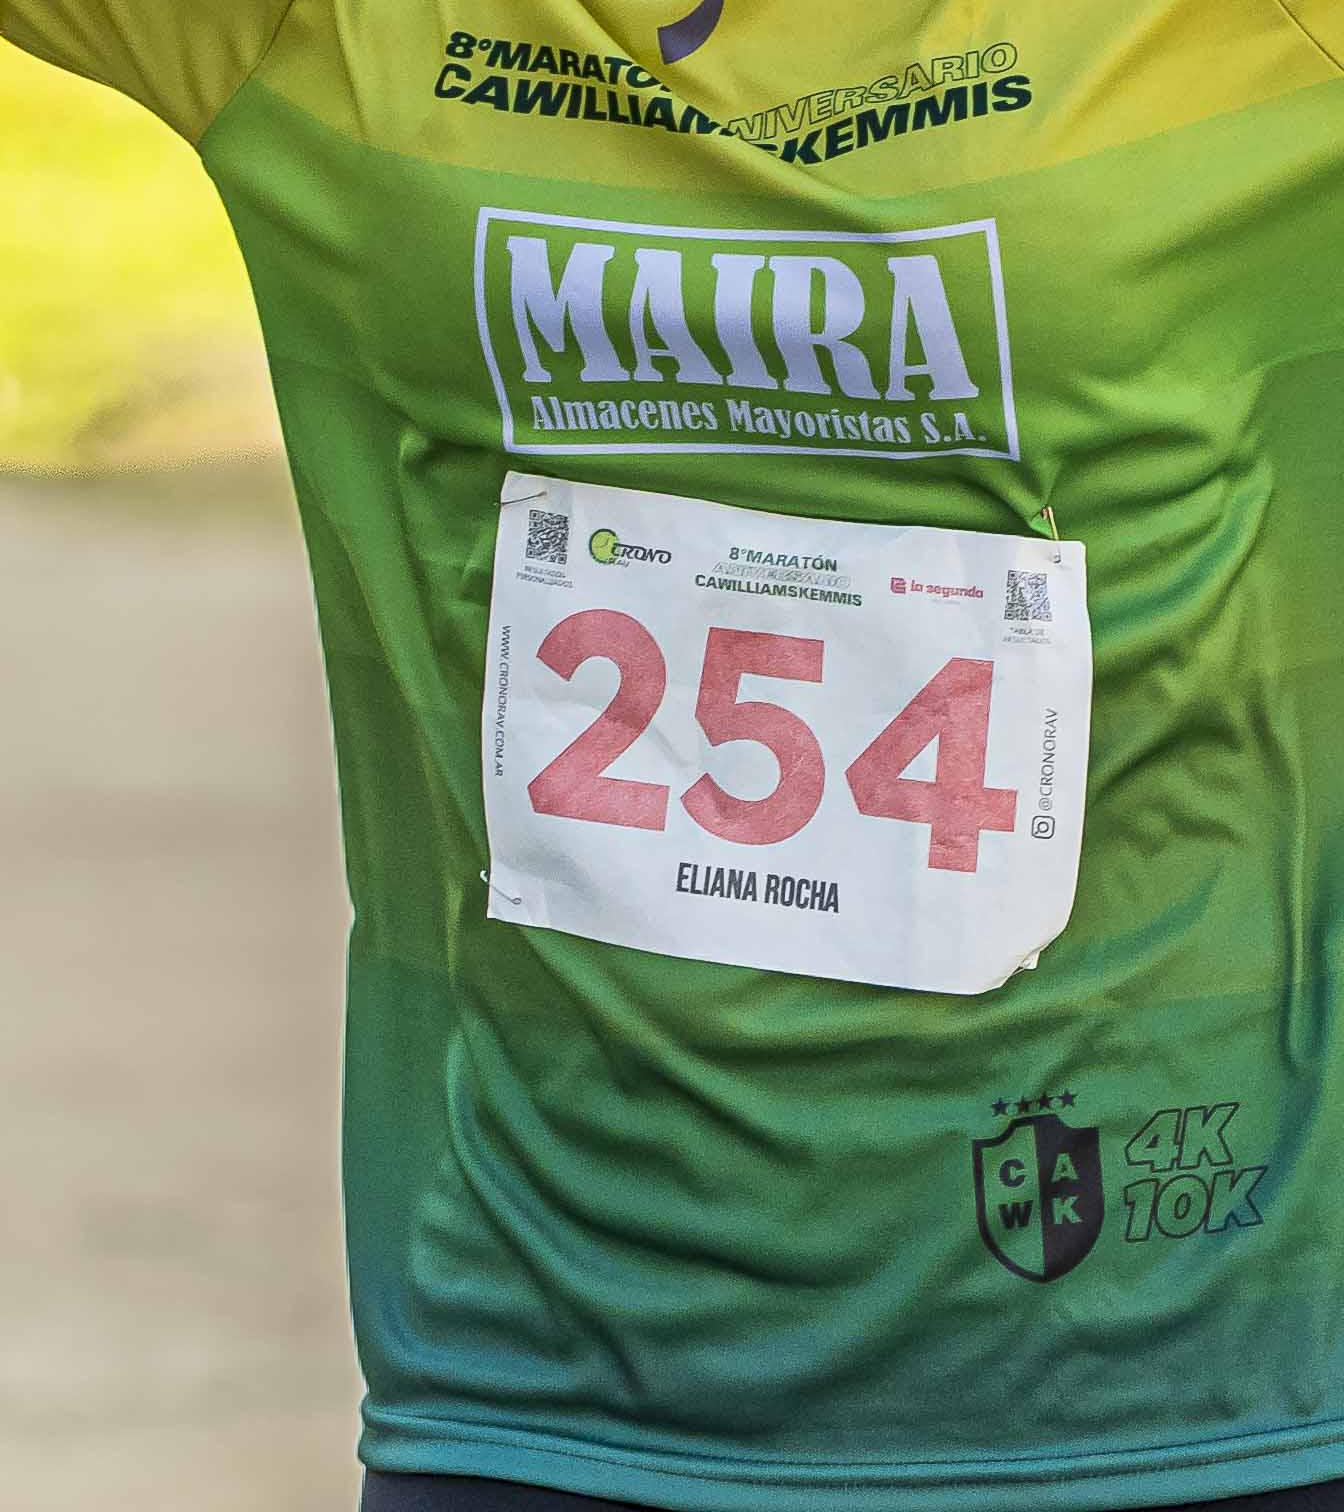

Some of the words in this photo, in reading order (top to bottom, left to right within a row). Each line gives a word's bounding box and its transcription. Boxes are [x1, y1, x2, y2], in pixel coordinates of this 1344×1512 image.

[728, 42, 1018, 141] NIVERSARIO
[506, 236, 980, 402] MAIRA
[530, 395, 718, 432] Almacenes
[725, 399, 912, 444] Mayoristas
[921, 412, 987, 444] S.A.
[695, 574, 862, 606] CAWILLIAMSKEMMIS
[911, 580, 923, 592] la
[926, 584, 984, 598] segunda
[495, 625, 511, 777] WWW.CRONORAV.COM.AR
[527, 608, 1018, 873] 254
[1039, 708, 1058, 811] @CRONORAV
[676, 862, 758, 903] ELIANA
[765, 873, 840, 914] ROCHA
[999, 1159, 1026, 1188] C
[1052, 1153, 1078, 1180] A
[1124, 1102, 1239, 1173] 4K
[999, 1200, 1033, 1229] W
[1052, 1196, 1082, 1225] K
[1123, 1166, 1268, 1242] 10K
